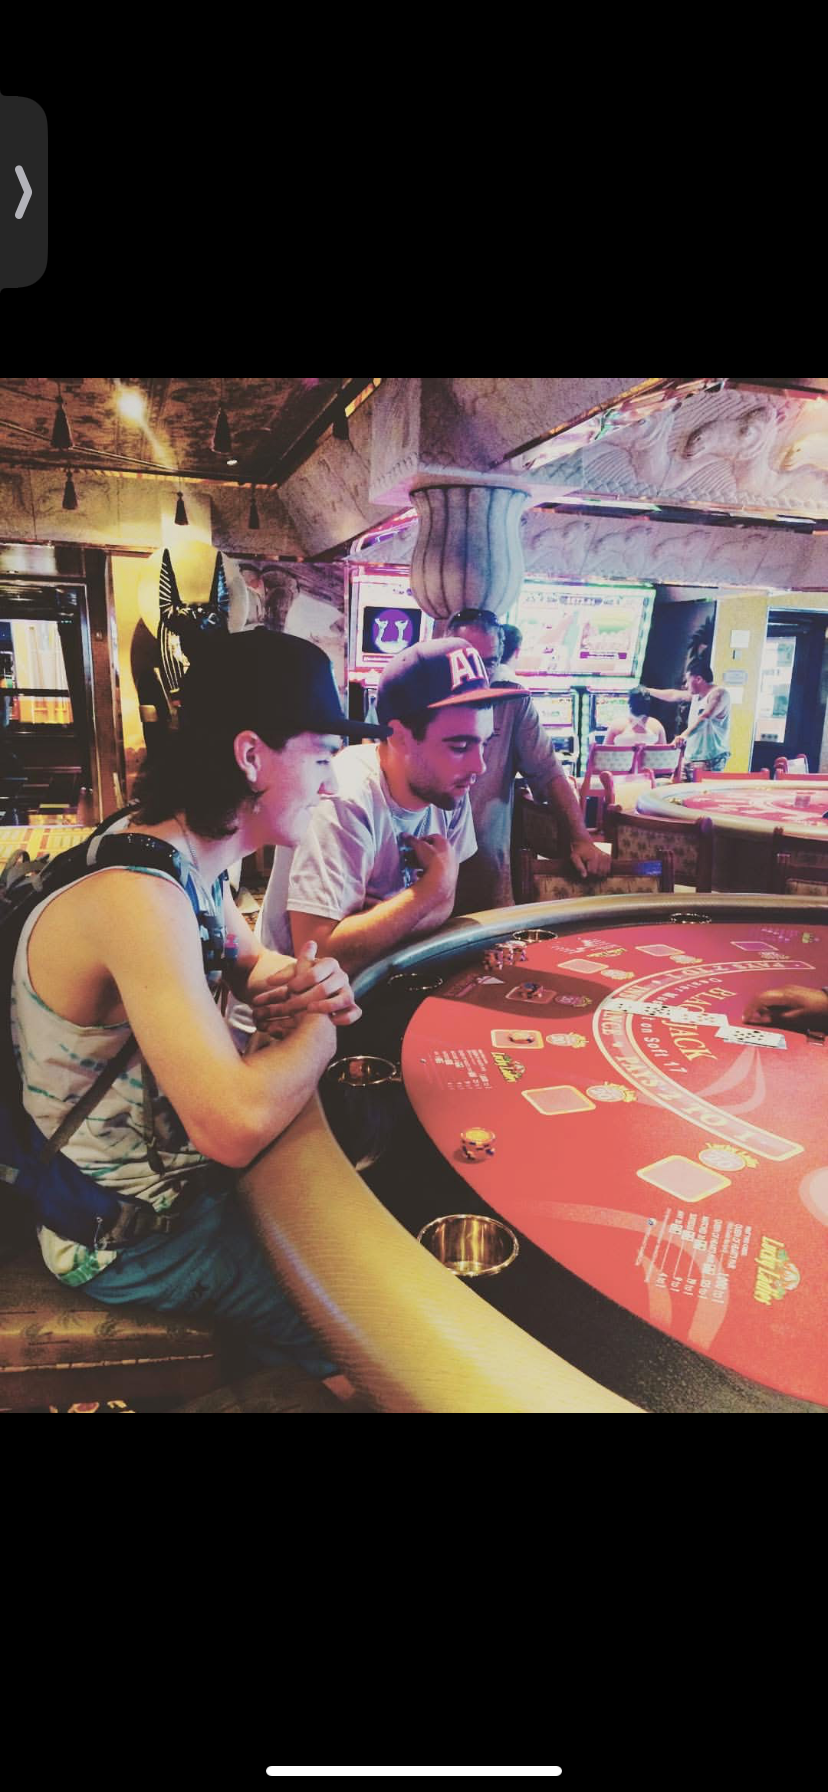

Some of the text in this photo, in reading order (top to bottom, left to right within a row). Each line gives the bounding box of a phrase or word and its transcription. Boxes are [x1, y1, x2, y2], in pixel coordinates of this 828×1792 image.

[640, 1022, 653, 1034] on
[643, 1036, 670, 1058] Soft
[663, 1061, 688, 1075] 17
[616, 1056, 658, 1088] PAYS
[683, 1103, 728, 1127] TO
[753, 1236, 785, 1305] Lucky Ladies
